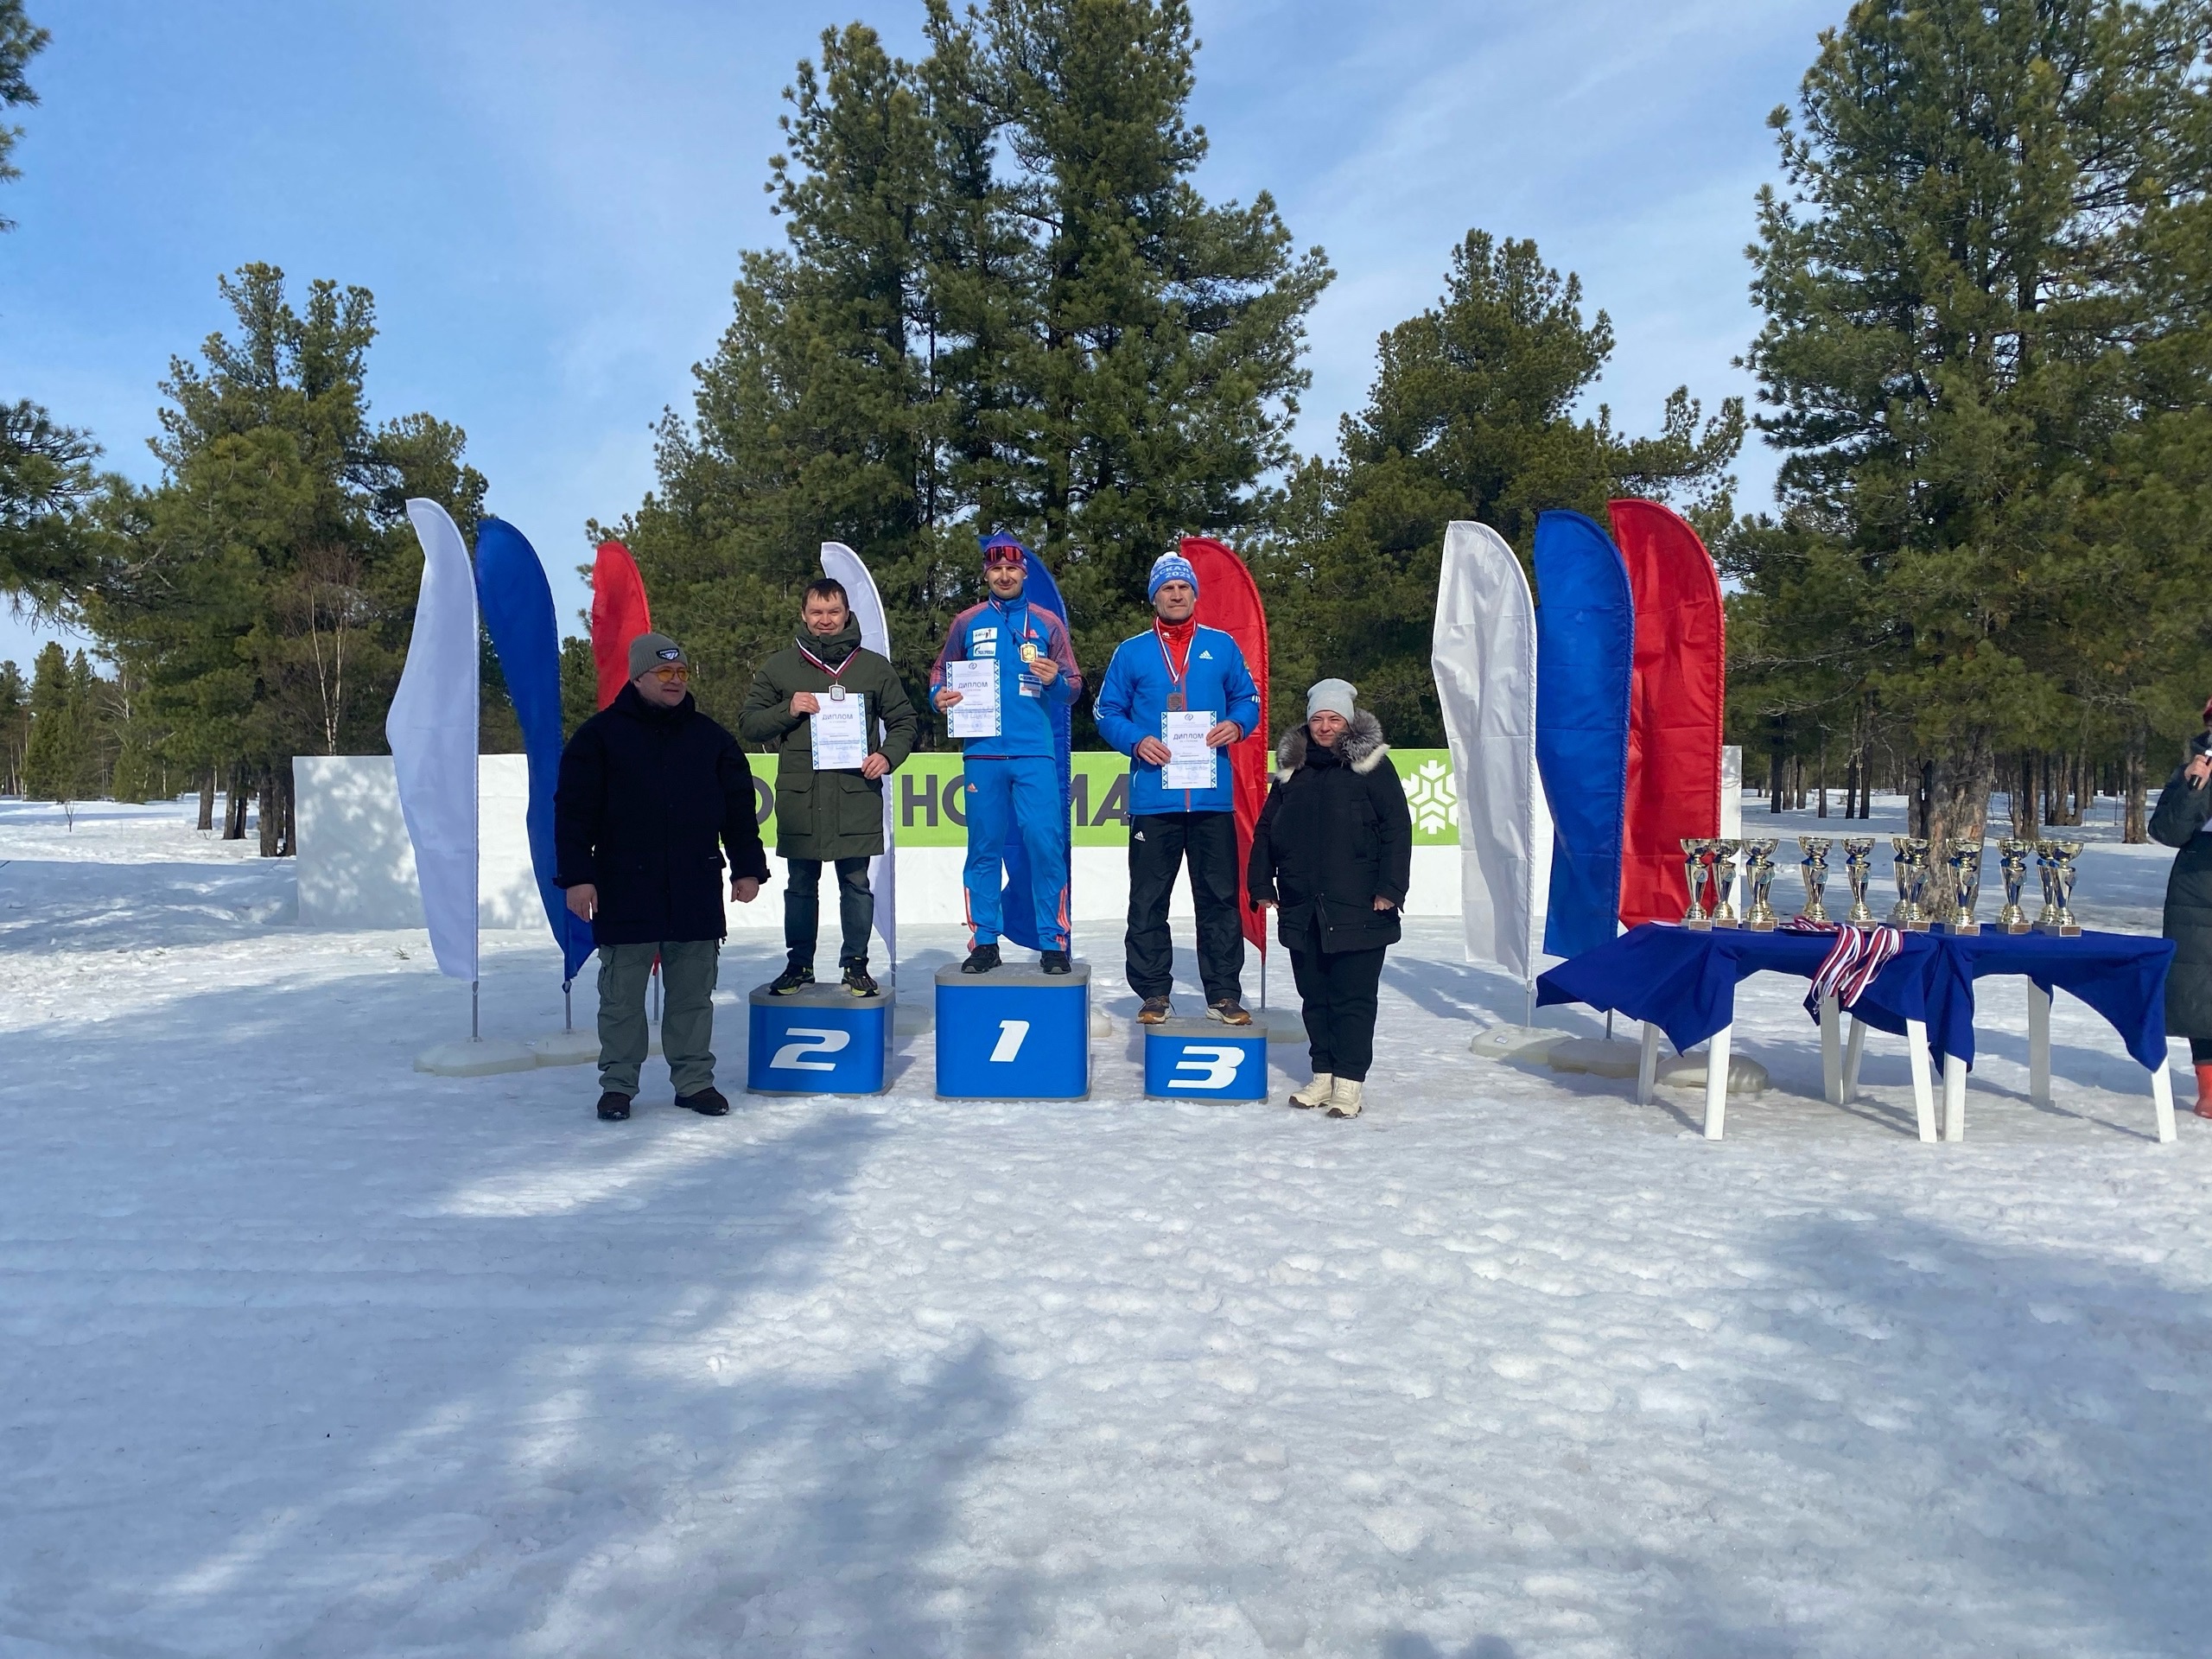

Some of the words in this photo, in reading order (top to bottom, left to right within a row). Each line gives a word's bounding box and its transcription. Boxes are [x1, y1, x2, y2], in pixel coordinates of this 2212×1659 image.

[958, 681, 988, 690] ДИПЛОМ
[769, 1027, 850, 1071] 2
[989, 1020, 1030, 1063] 1
[1167, 1046, 1245, 1090] 3
